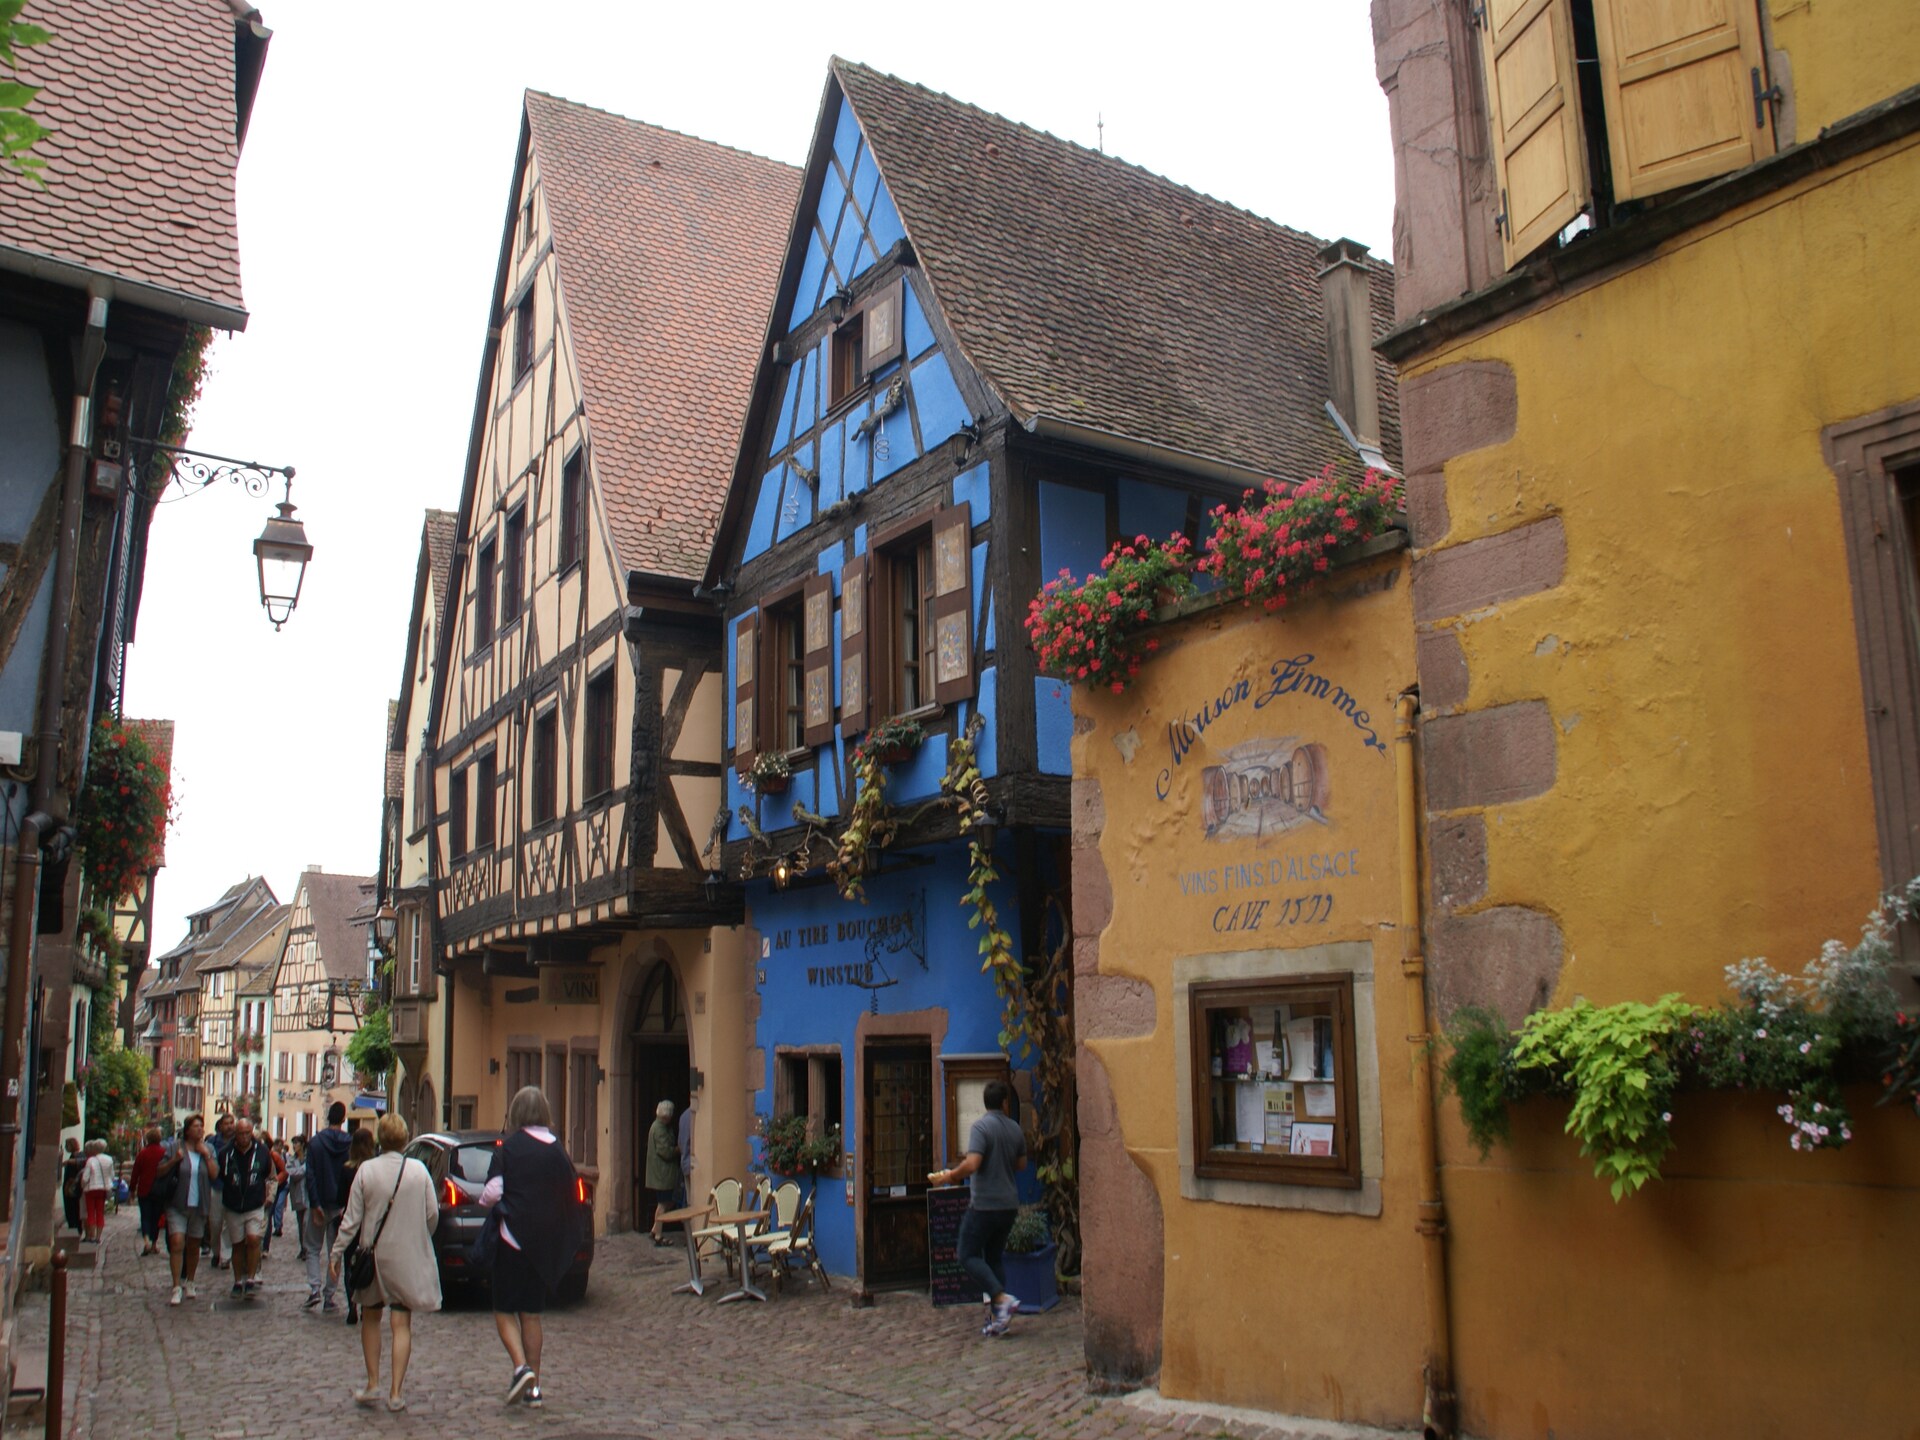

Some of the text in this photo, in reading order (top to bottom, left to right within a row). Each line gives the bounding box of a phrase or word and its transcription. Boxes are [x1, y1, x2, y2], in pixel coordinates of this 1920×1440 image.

[1156, 654, 1387, 801] Maison Zimmer
[1180, 849, 1360, 897] VINS FINS D'ALSACE
[1212, 900, 1270, 934] CAVE
[775, 929, 792, 951] AU
[798, 924, 829, 949] TIRE
[807, 961, 874, 988] WINSTUB
